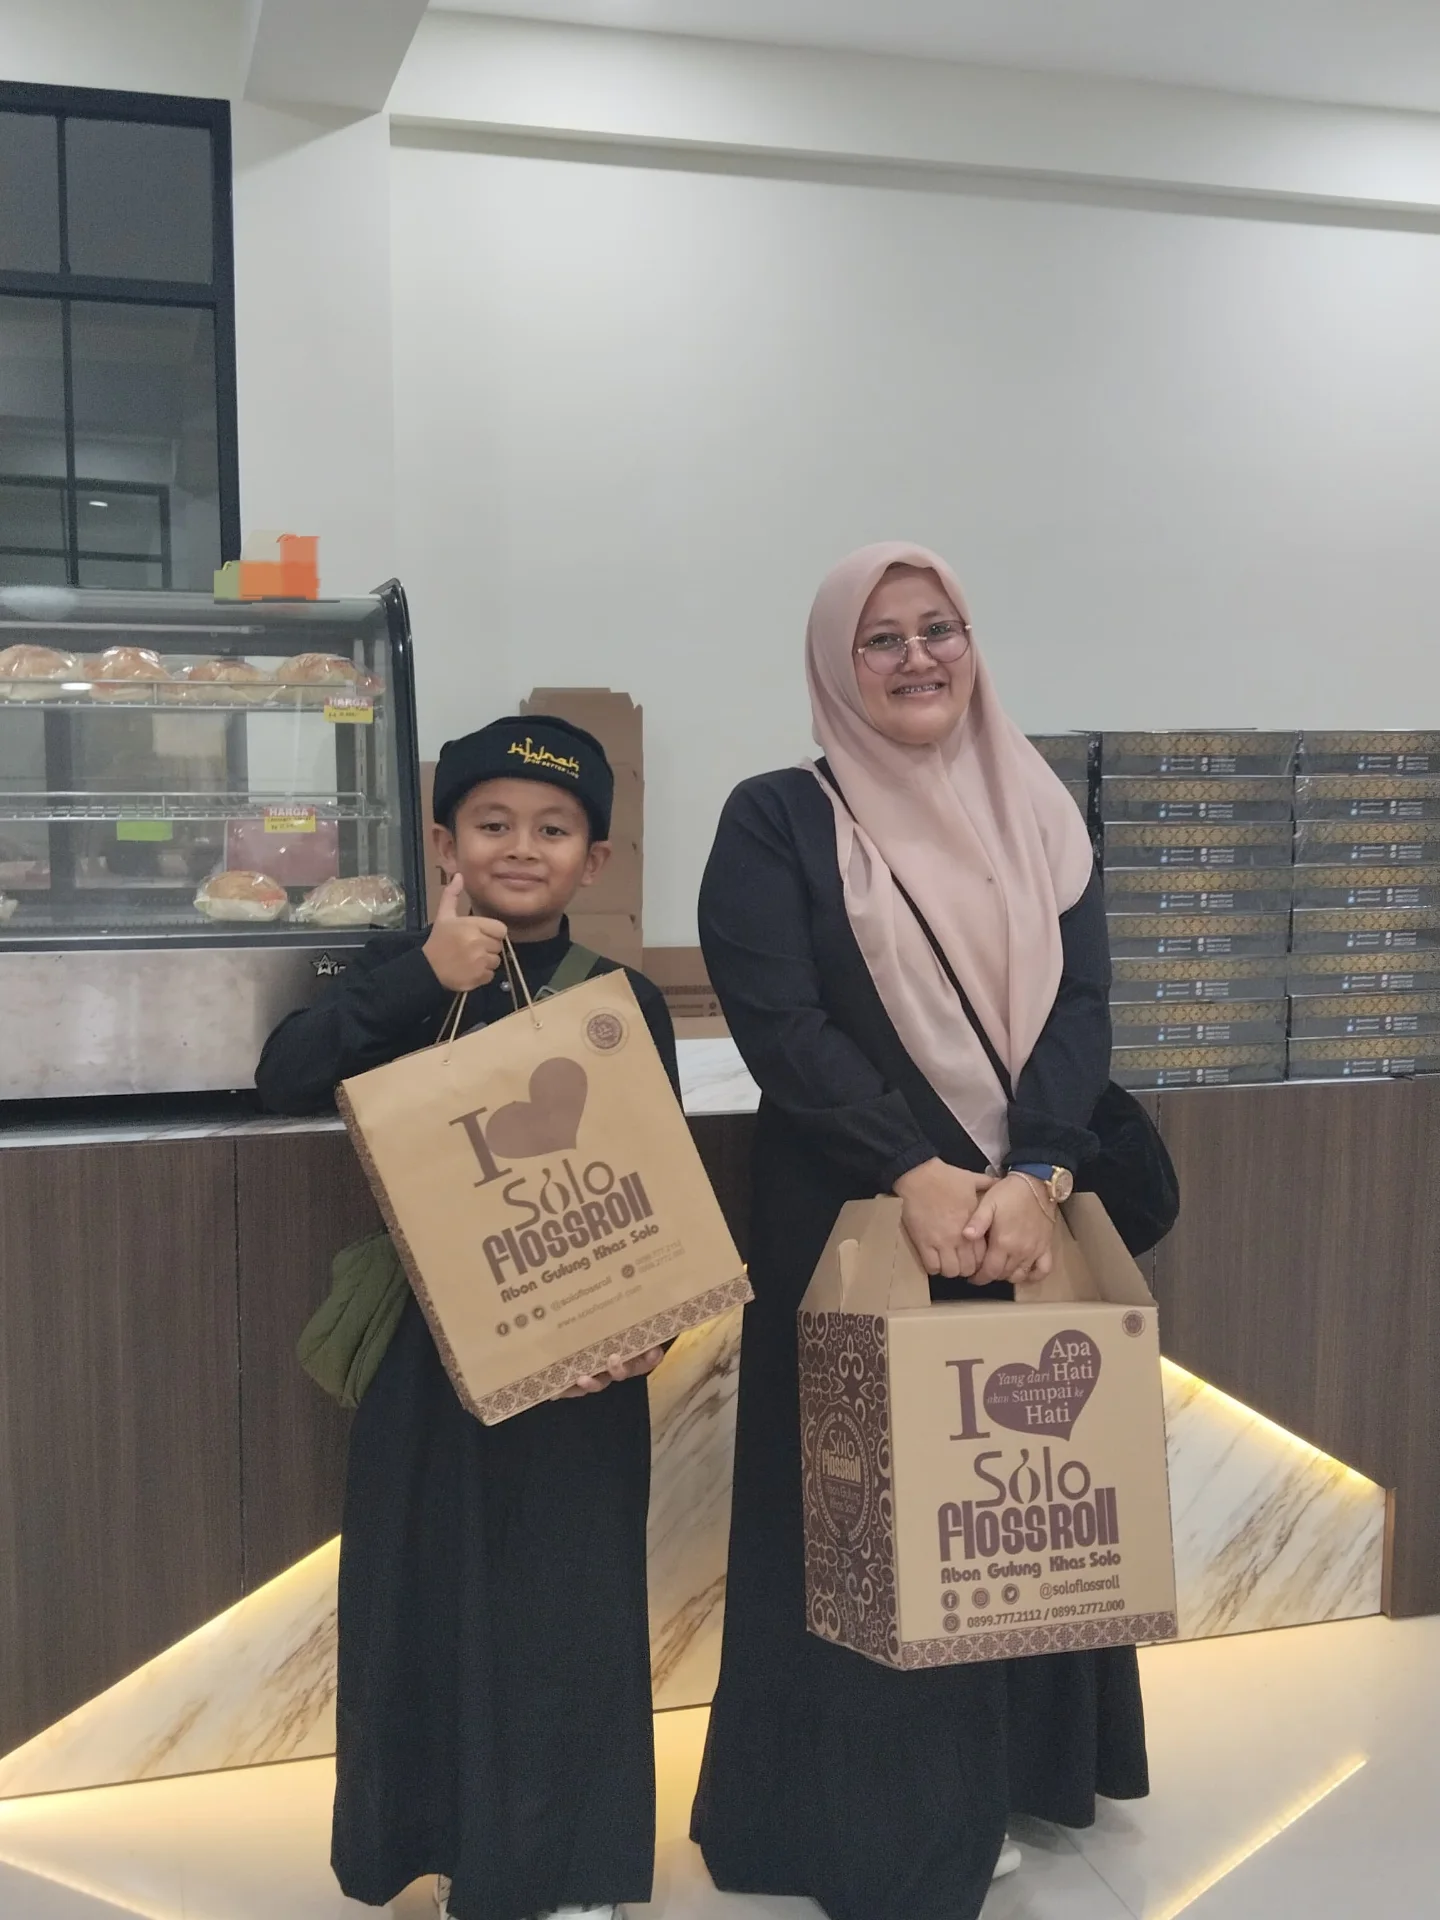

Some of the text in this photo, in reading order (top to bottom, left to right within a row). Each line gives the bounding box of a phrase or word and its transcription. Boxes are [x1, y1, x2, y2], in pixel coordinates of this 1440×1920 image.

[329, 697, 369, 708] HARGA
[270, 807, 309, 817] HARGA
[449, 1107, 512, 1189] I
[502, 1158, 615, 1232] Solo
[500, 1224, 660, 1304] Abon Gulung Khas Solo
[1050, 1339, 1092, 1363] Apa
[997, 1360, 1094, 1387] Yang dari Hati
[945, 1358, 990, 1442] I
[1012, 1381, 1072, 1404] sampai
[1074, 1386, 1084, 1397] ke
[1025, 1402, 1071, 1425] Hati
[828, 1429, 856, 1459] Solo
[974, 1446, 1091, 1508] Solo
[940, 1550, 1121, 1584] Abon Gulung Khas Solo
[1039, 1574, 1120, 1600] @soloflossroll
[967, 1609, 1042, 1629] 0899.777.2112
[1051, 1599, 1125, 1618] 0899.2772.000
